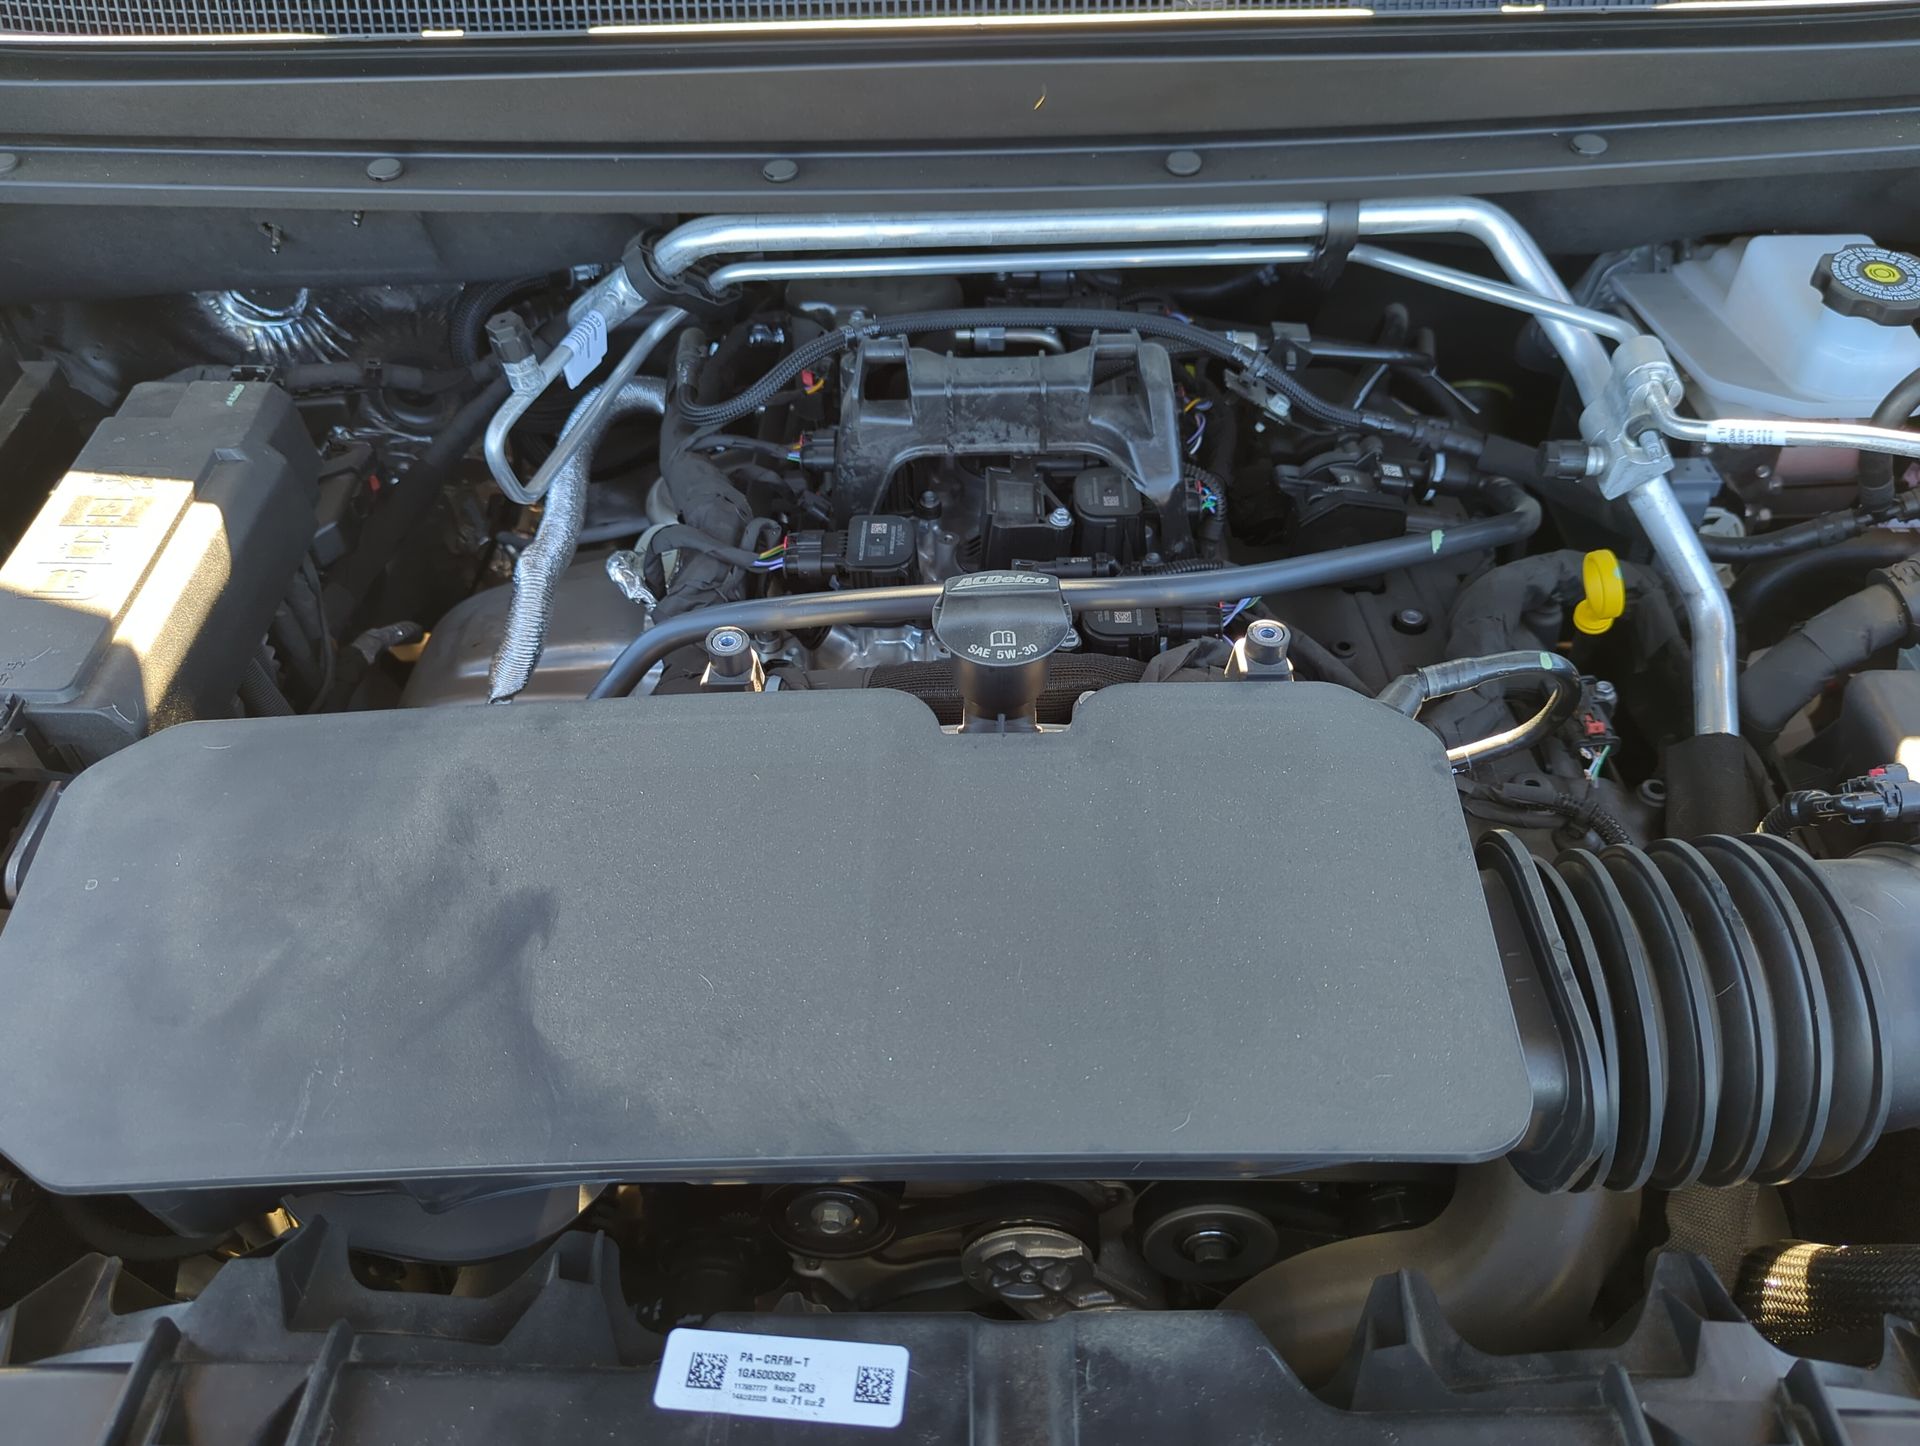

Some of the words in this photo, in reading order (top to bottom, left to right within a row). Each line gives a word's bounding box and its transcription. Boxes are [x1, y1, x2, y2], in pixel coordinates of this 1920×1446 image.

[955, 575, 1050, 587] ACDelco
[967, 644, 991, 659] SAE
[996, 643, 1039, 660] 5W-30
[798, 1382, 816, 1394] CR3
[790, 1394, 802, 1406] 71
